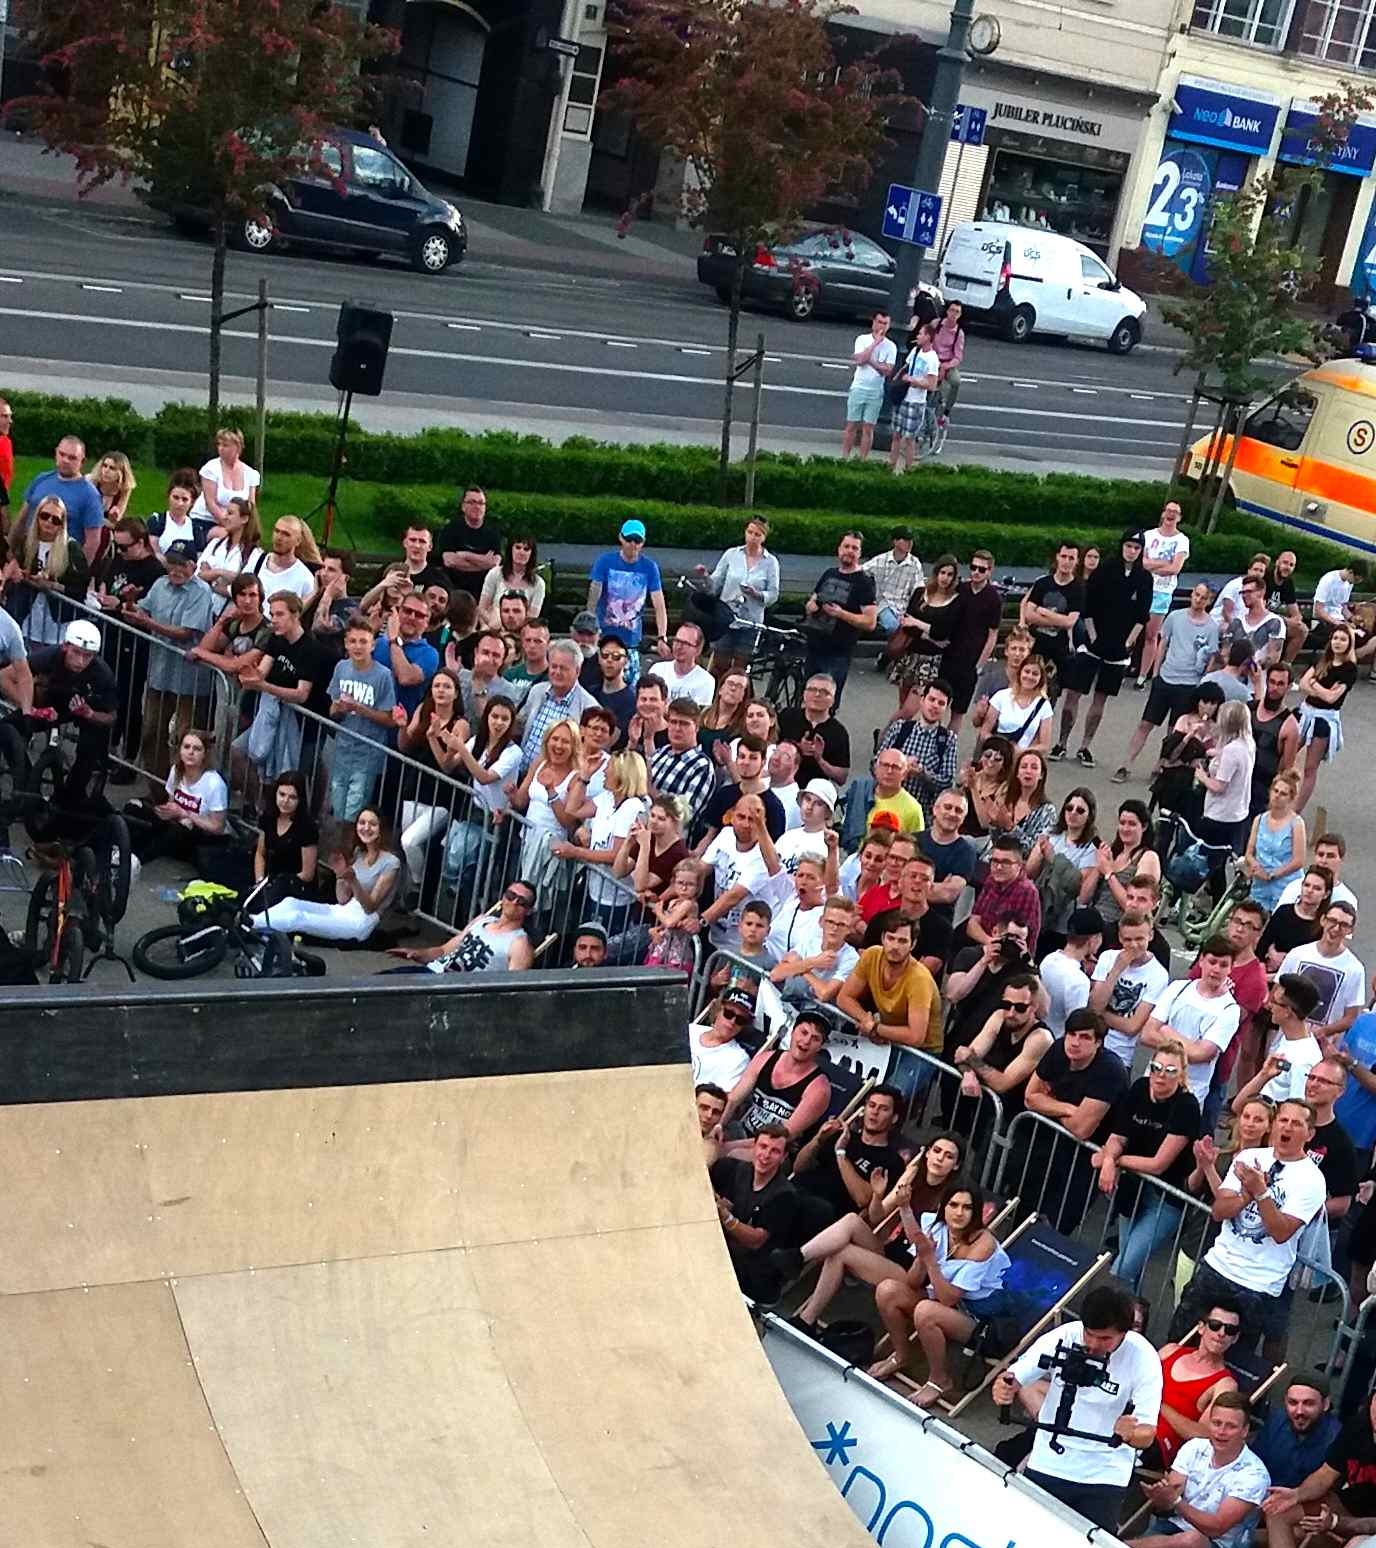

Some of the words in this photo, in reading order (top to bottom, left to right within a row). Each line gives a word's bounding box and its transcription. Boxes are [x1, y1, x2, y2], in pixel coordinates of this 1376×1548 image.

[991, 102, 1041, 126] JUBILER
[1041, 112, 1103, 137] PLUCIŃSKI
[1232, 116, 1262, 133] BANK
[1353, 427, 1369, 447] S
